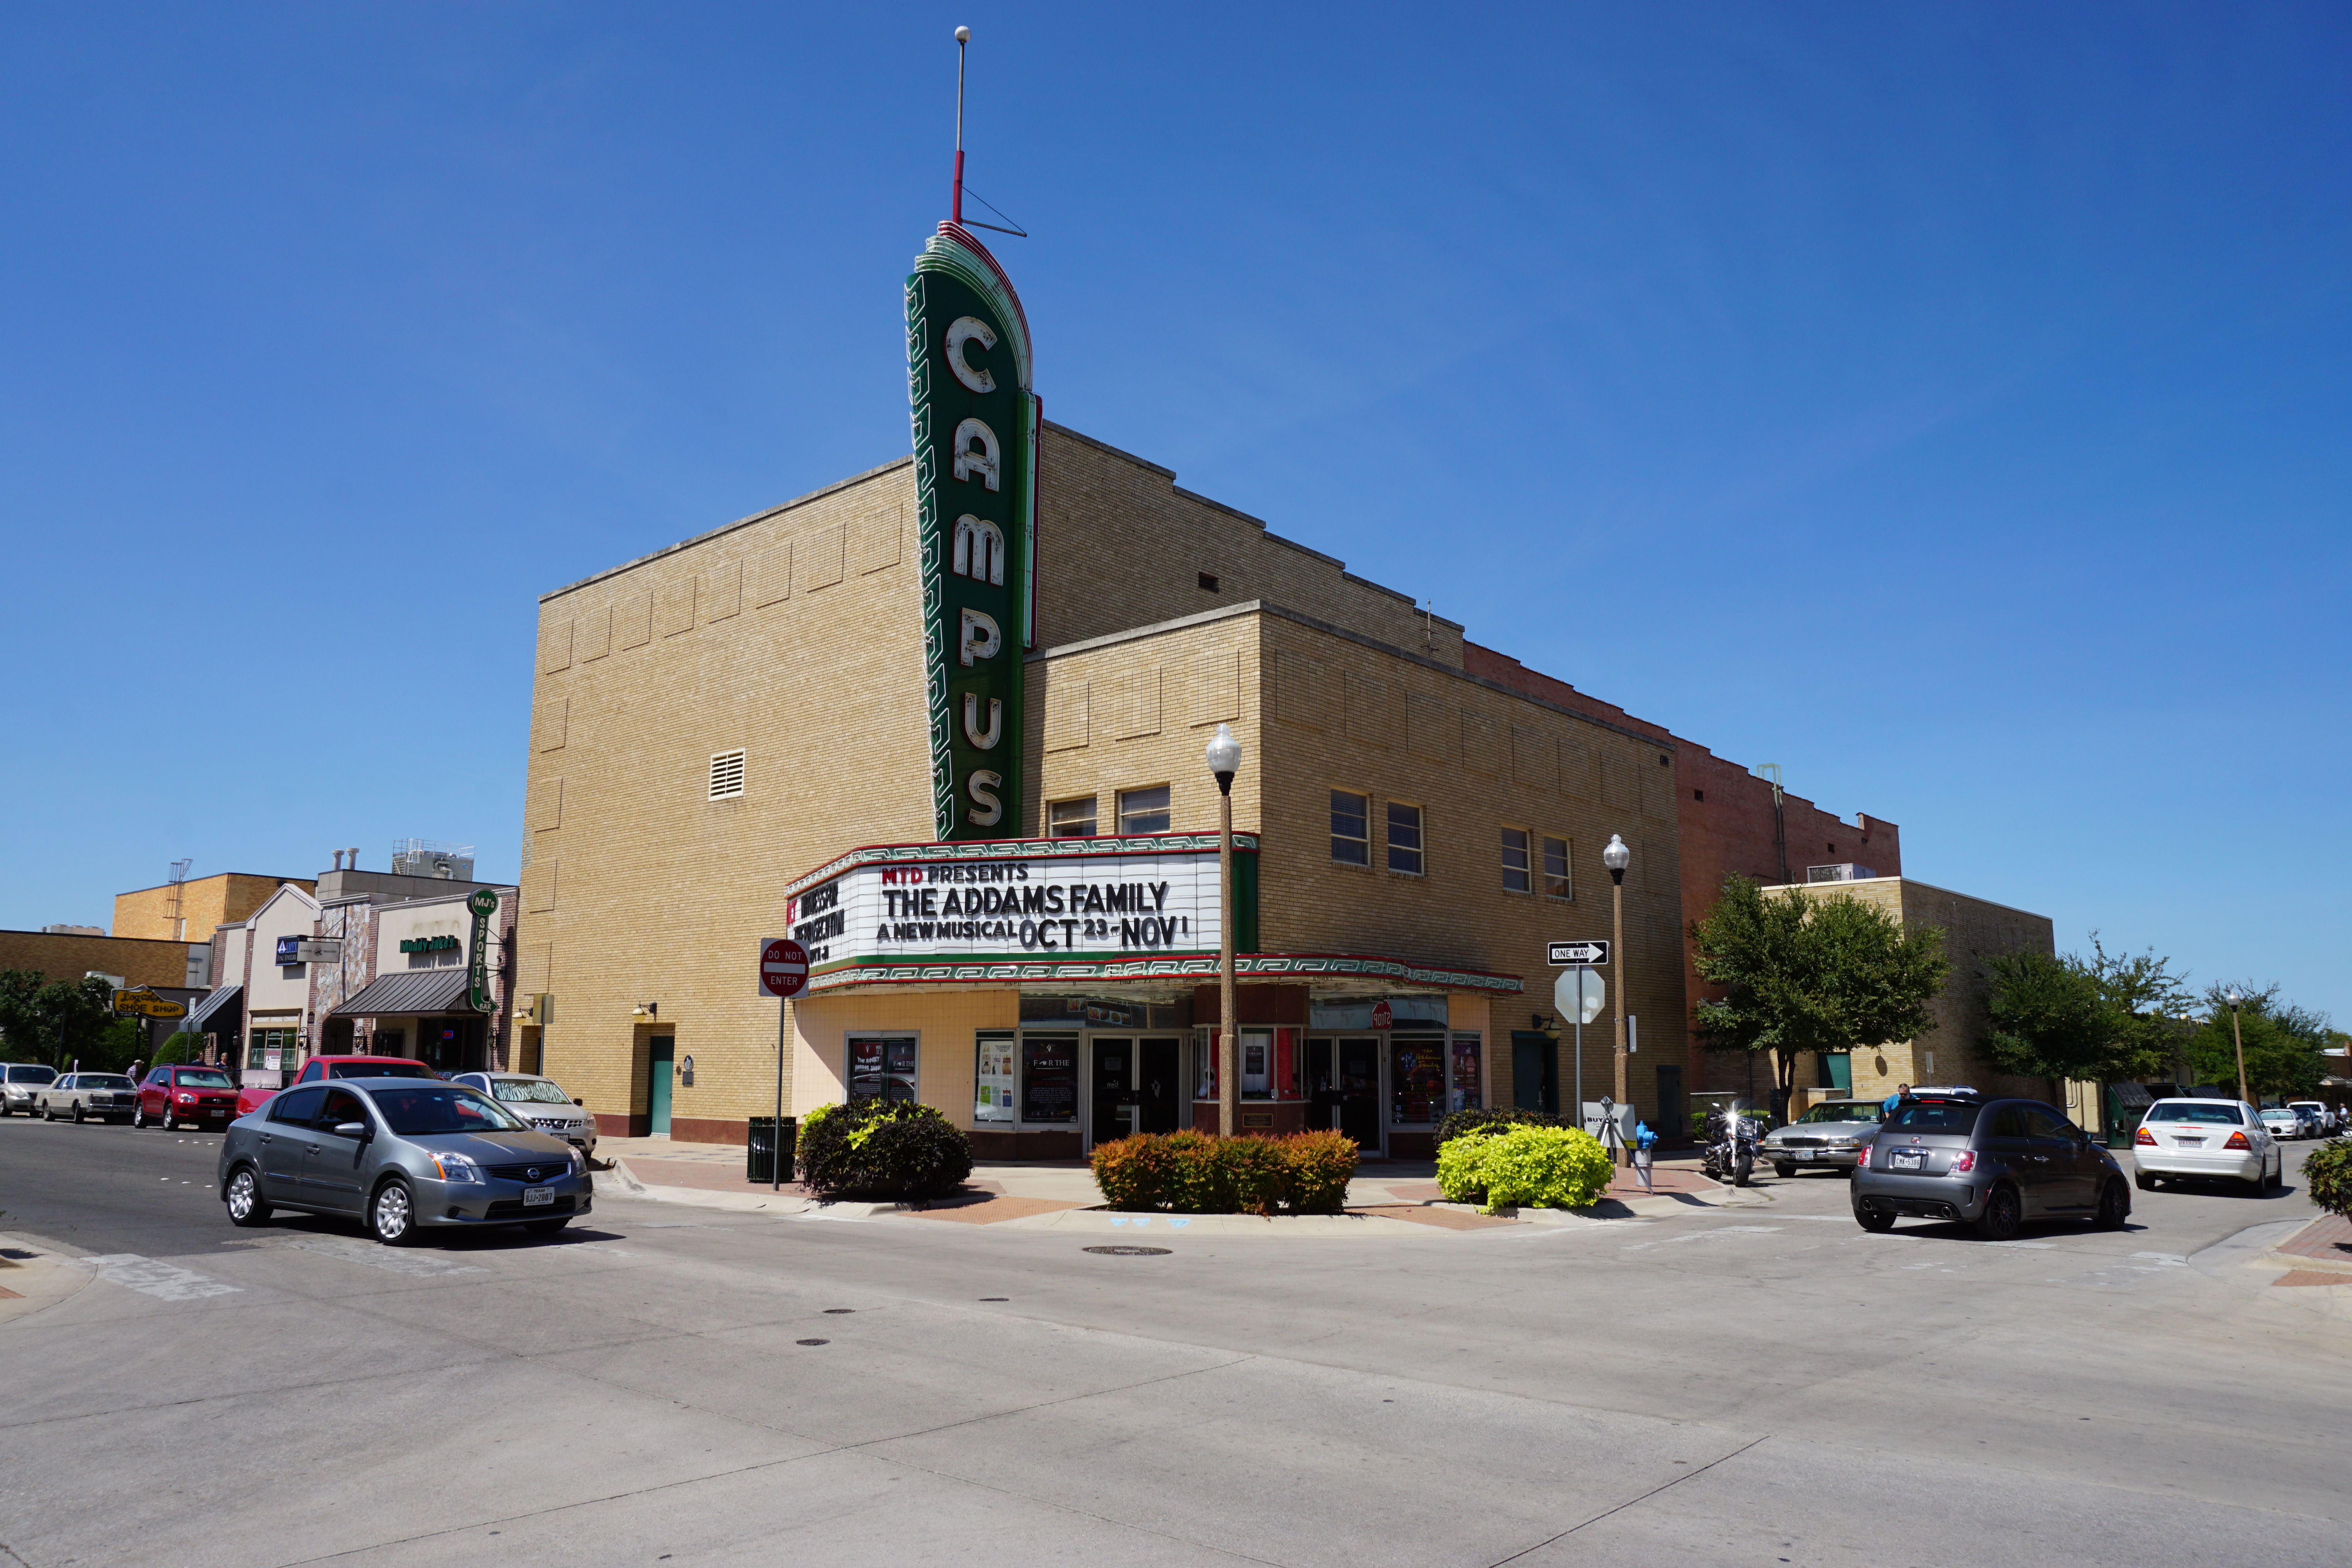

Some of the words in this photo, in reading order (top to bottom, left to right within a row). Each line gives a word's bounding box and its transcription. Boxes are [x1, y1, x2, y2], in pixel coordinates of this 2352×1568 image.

[944, 316, 1004, 826] CAMPUS
[882, 867, 923, 884] MTD
[928, 864, 1028, 882] PRESENTS
[475, 897, 495, 908] MJ's
[882, 888, 937, 916] THE
[942, 885, 1064, 915] ADDAMS
[1070, 881, 1167, 913] FAMILY
[877, 923, 890, 939] A
[894, 922, 934, 939] NEW
[937, 920, 1017, 938] MUSICAL
[1019, 918, 1079, 948] OCT
[400, 938, 428, 953] Muddy
[429, 935, 455, 950] Jake's
[474, 917, 485, 988] SPORTS
[768, 950, 780, 960] DO
[785, 951, 802, 960] NOT
[1555, 949, 1571, 958] ONE
[1573, 949, 1589, 957] WAY
[771, 976, 798, 985] ENTER
[855, 1064, 869, 1073] HORROR
[1418, 1060, 1441, 1070] Family
